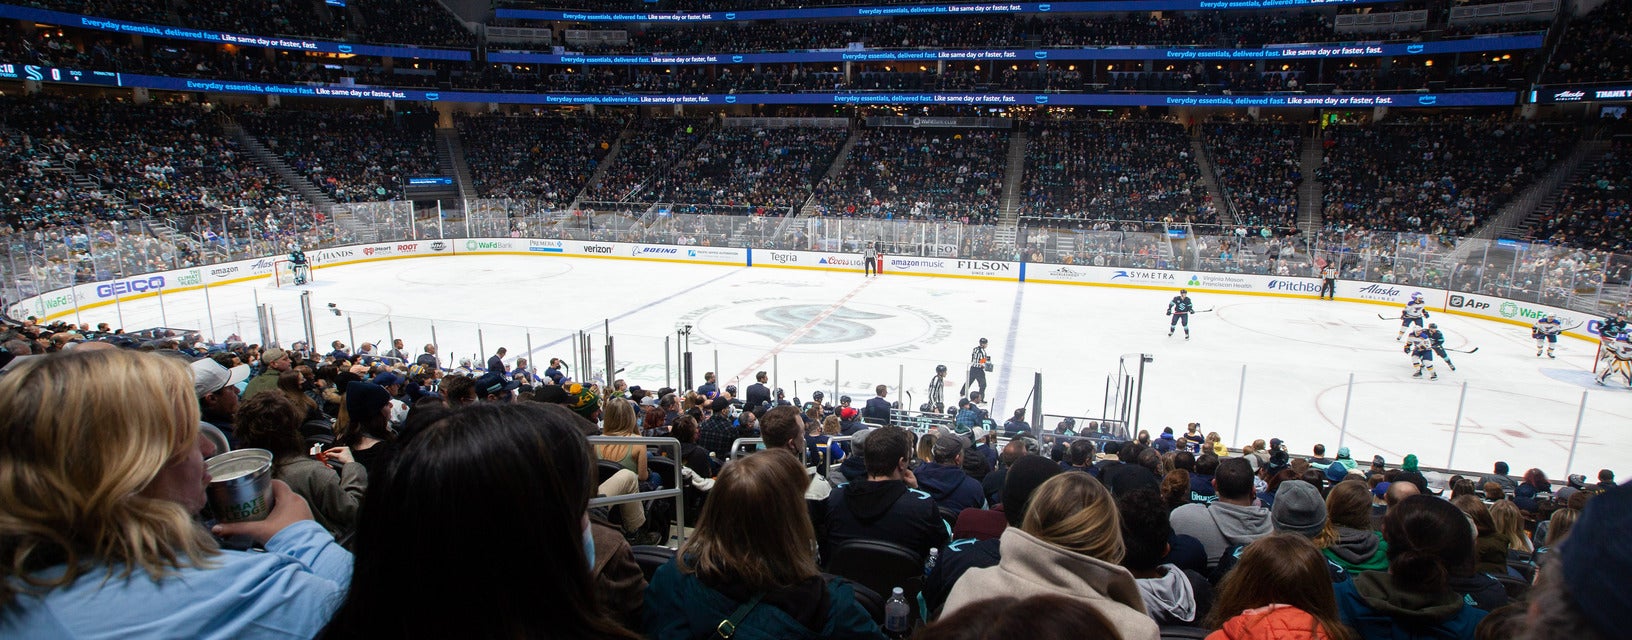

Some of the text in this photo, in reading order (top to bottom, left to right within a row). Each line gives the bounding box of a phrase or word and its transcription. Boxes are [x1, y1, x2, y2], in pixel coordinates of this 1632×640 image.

[82, 18, 120, 30] Everyday
[165, 29, 202, 38] delivered
[52, 68, 61, 80] 0
[187, 81, 223, 90] Everyday
[1596, 90, 1626, 98] THANK
[1324, 97, 1338, 105] day
[584, 244, 612, 254] verizon
[323, 250, 354, 260] HANDS
[770, 252, 797, 263] Tegria
[251, 258, 275, 269] Alas
[828, 256, 849, 266] Coors
[958, 261, 1010, 271] FILSON
[210, 266, 238, 275] amazon
[97, 276, 165, 298] GEICO
[1360, 284, 1400, 297] Alaska
